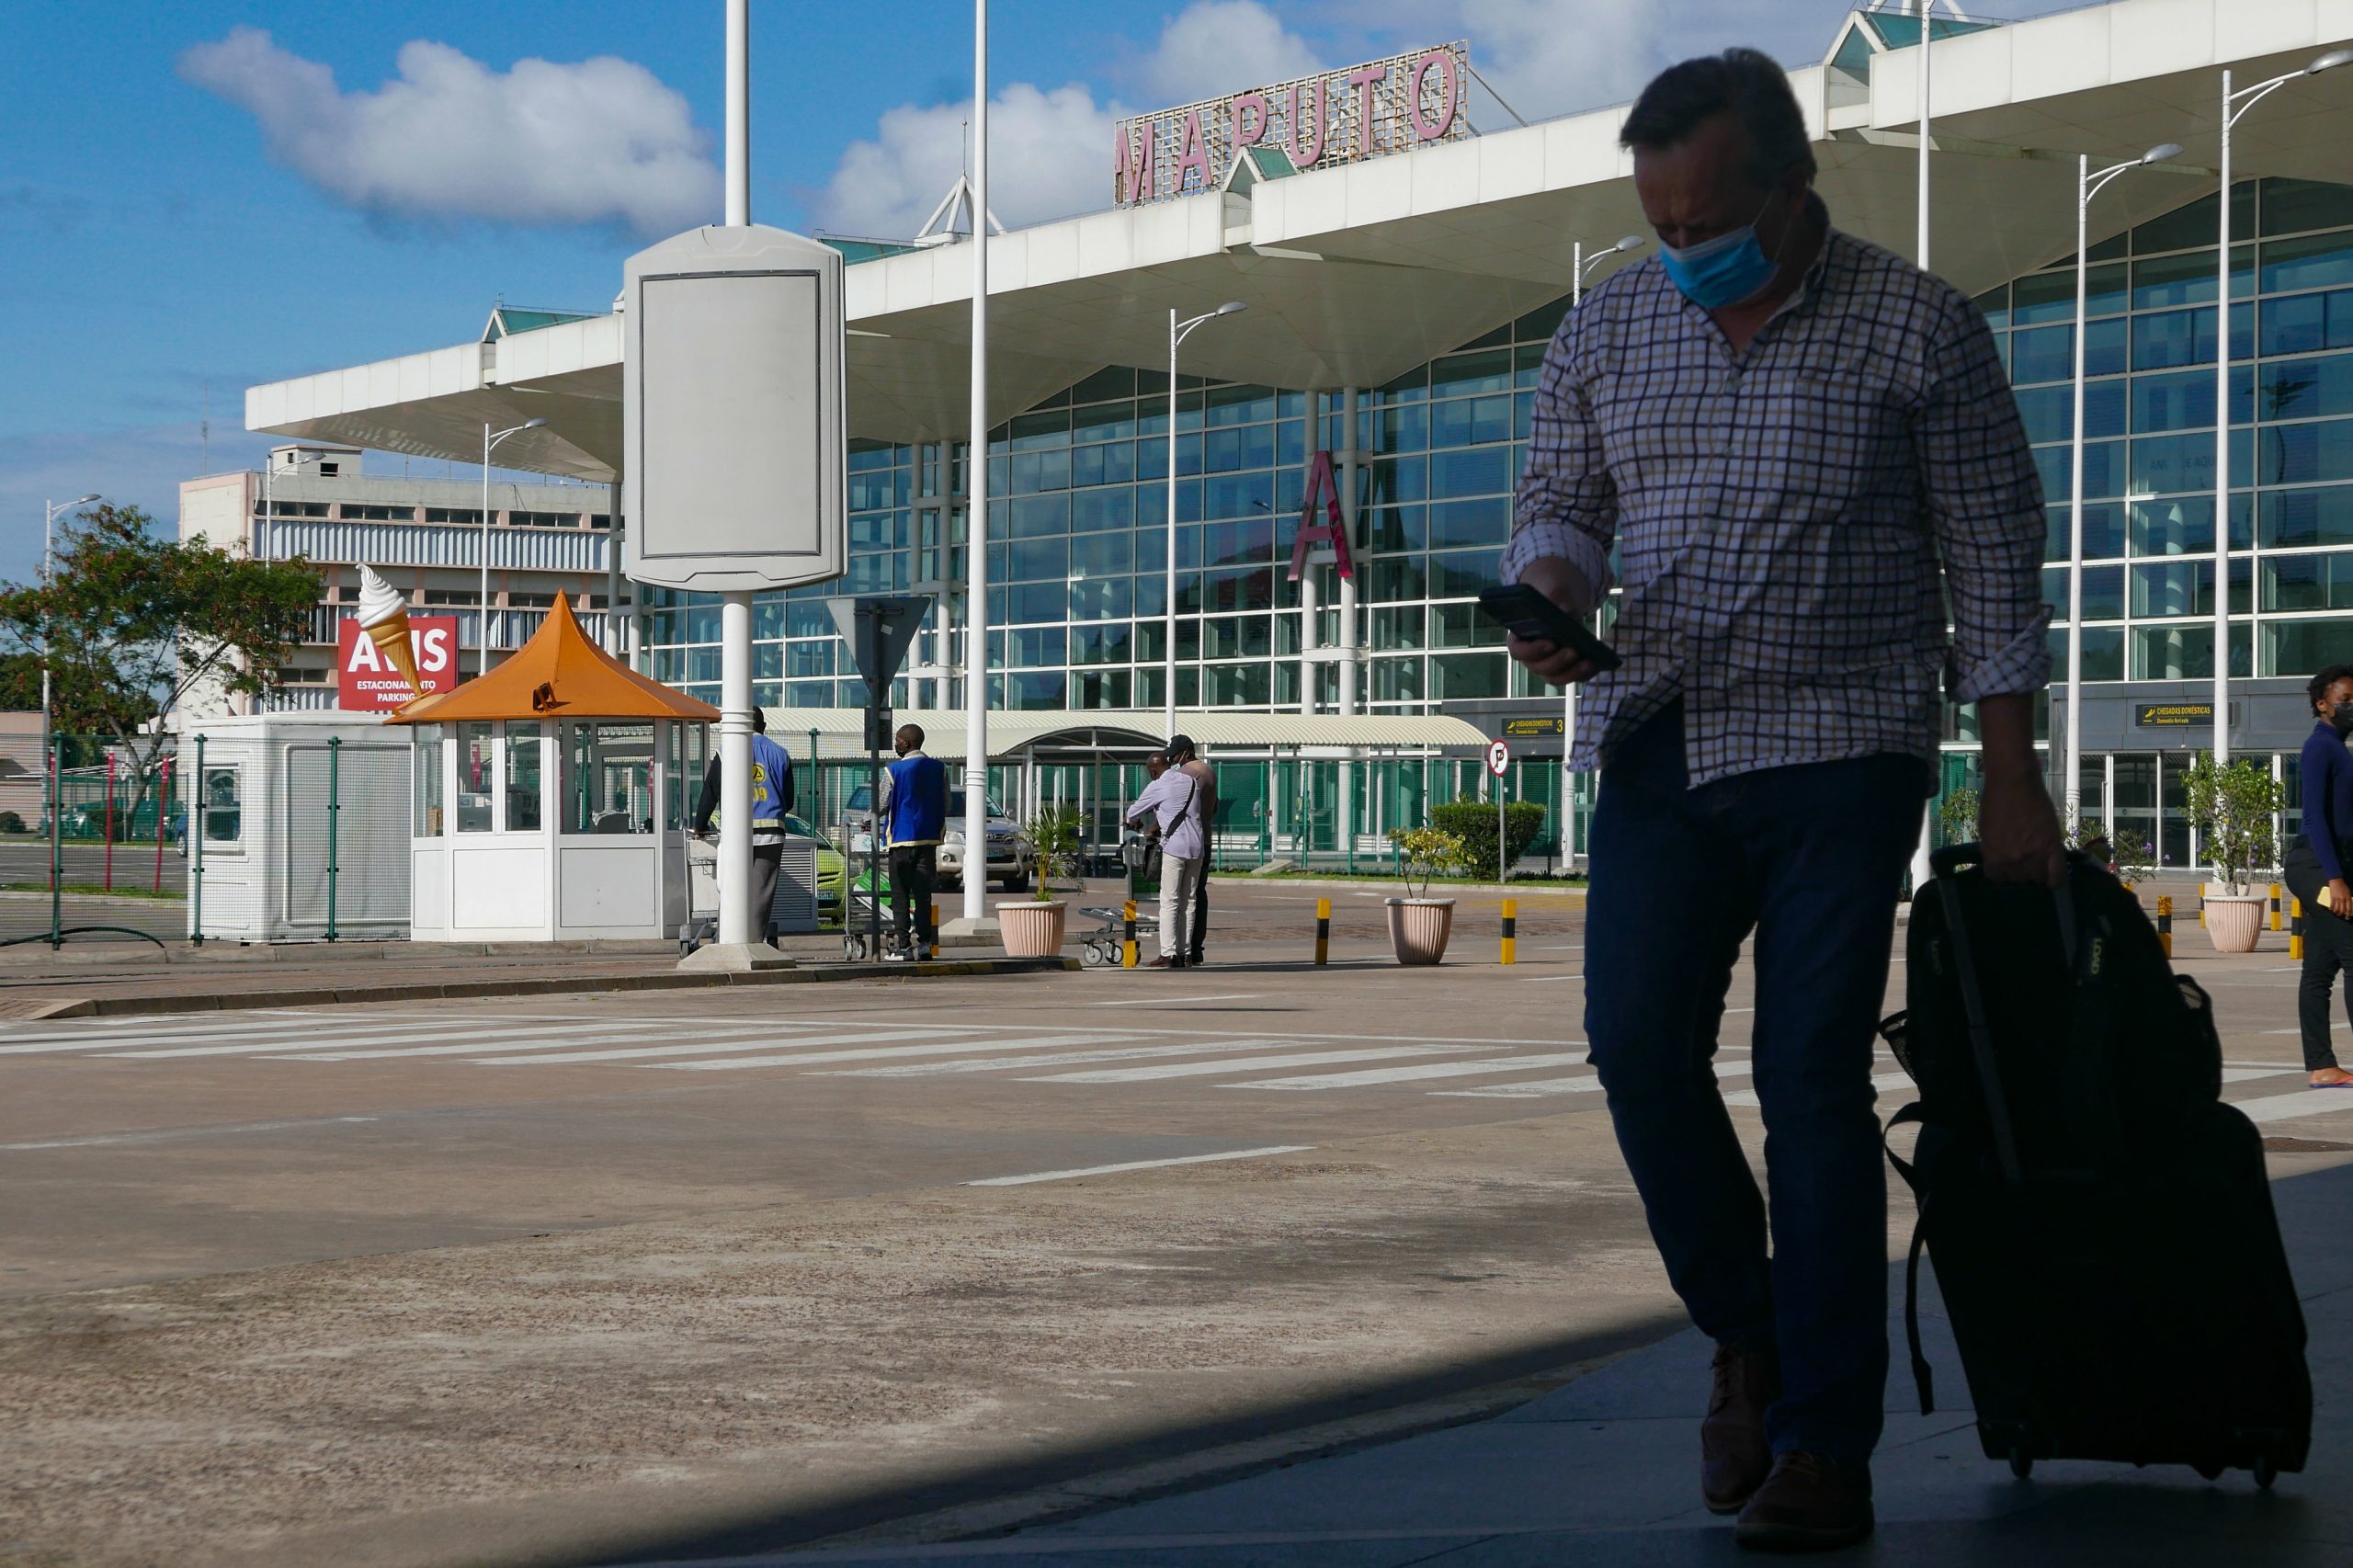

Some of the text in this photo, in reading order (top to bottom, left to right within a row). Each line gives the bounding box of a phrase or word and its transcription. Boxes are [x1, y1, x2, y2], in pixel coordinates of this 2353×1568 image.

[1116, 51, 1458, 202] MAPUTO
[1287, 450, 1354, 581] A
[347, 629, 448, 672] AIS
[357, 680, 436, 689] ESTACIONAMNTO
[377, 693, 415, 702] PARKING
[2156, 705, 2211, 715] CHEGADAS DOMÉSTICAS
[1556, 719, 1563, 733] 3
